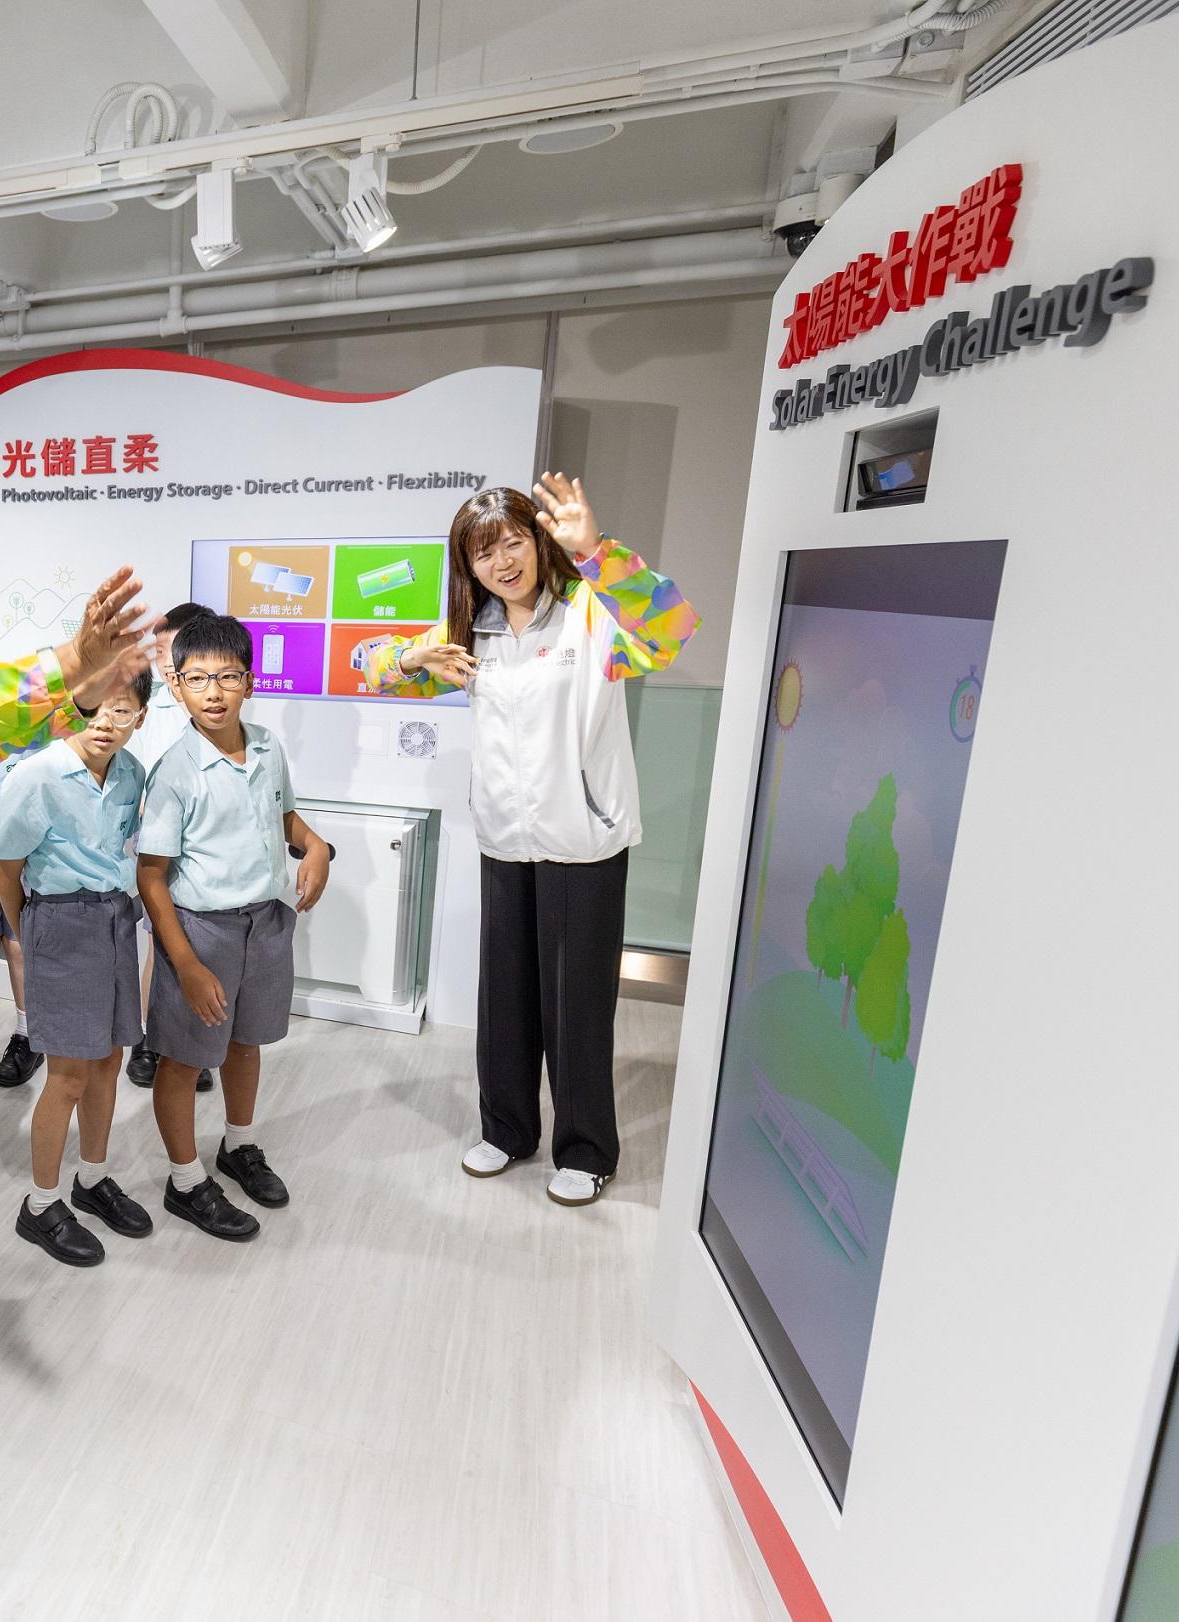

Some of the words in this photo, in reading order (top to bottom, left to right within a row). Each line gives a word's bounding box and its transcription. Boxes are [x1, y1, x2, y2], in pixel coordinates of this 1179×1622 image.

[778, 163, 1023, 369] 太陽能大作戰
[769, 379, 824, 431] Solar
[823, 344, 922, 408] Energy
[921, 256, 1155, 377] Challenge
[1, 433, 160, 478] 光儲直柔
[1, 484, 97, 503] Photovoltaic
[107, 484, 164, 503] Energy
[167, 481, 233, 500] Storage
[244, 478, 299, 495] Direct
[302, 476, 374, 494] Current
[386, 471, 487, 492] Flexibility
[249, 604, 303, 616] 太陽能光伏
[373, 605, 396, 617] 儲能
[252, 679, 294, 690] 柔性用電
